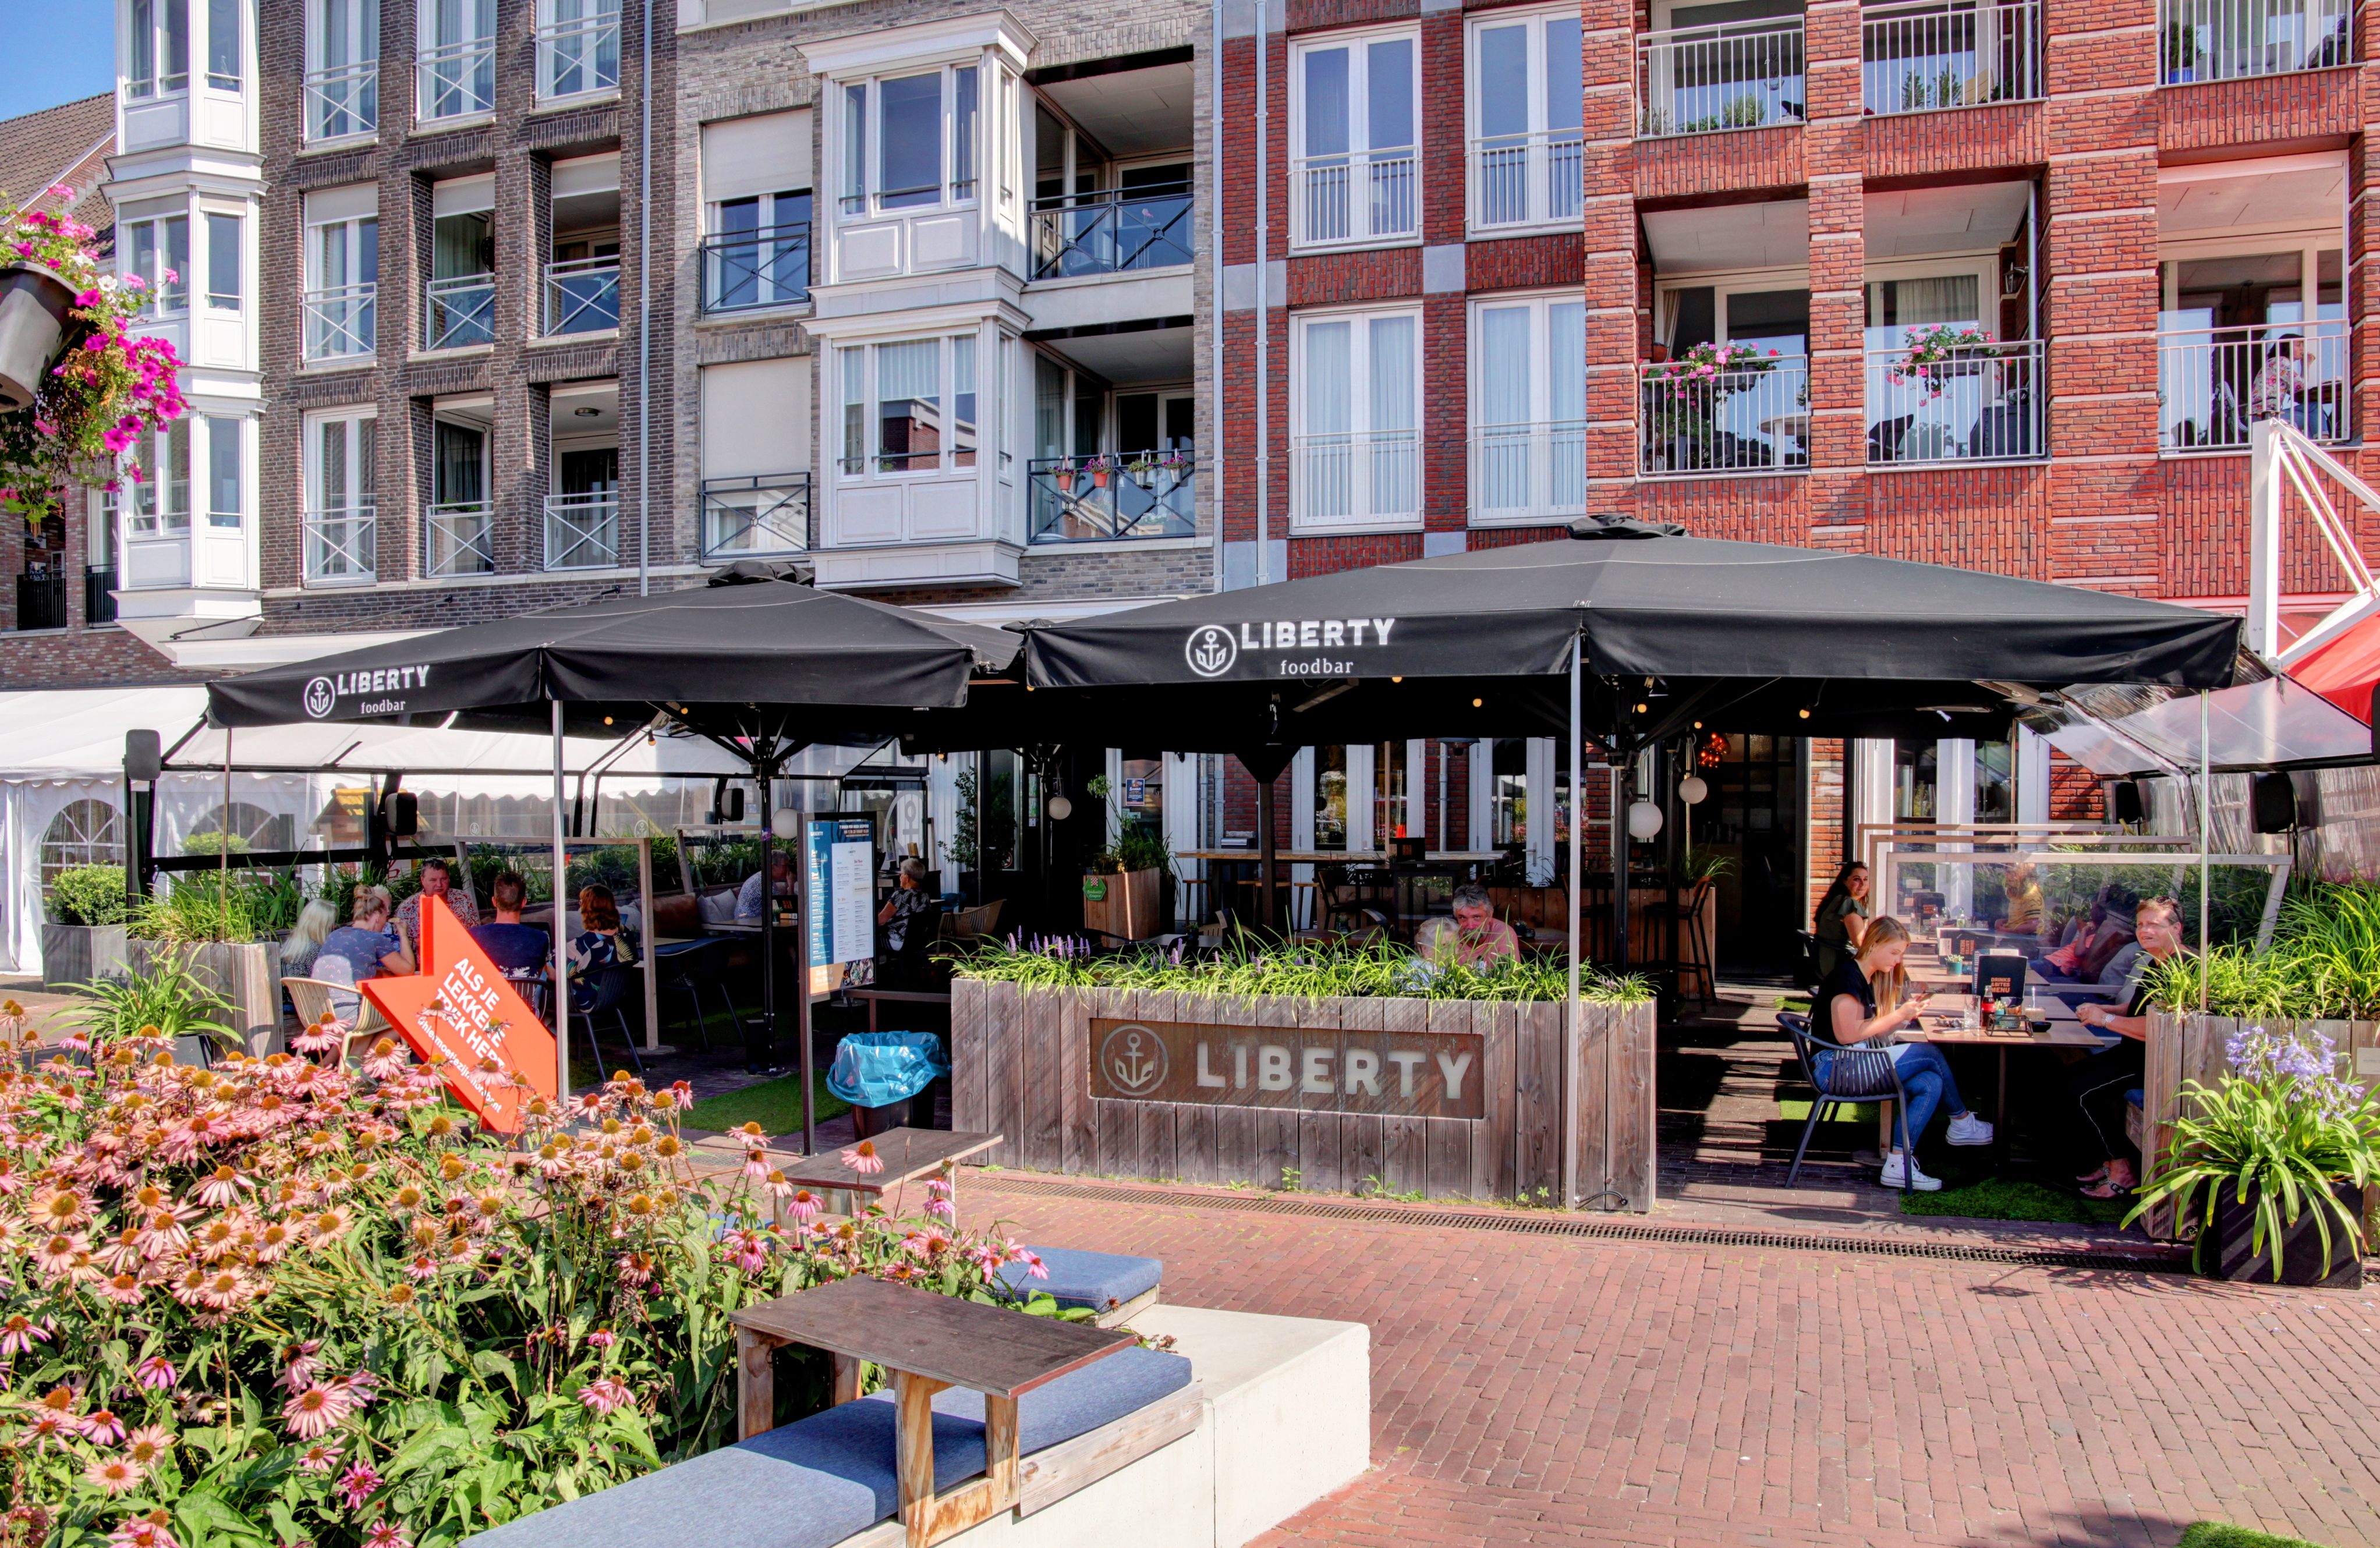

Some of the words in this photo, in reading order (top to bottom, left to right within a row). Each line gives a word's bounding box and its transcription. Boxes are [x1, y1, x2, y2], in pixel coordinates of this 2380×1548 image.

[1241, 618, 1395, 649] LIBERTY
[337, 664, 430, 695] LIBERTY
[1281, 658, 1354, 675] foodbar
[360, 699, 406, 714] foodbar
[454, 958, 484, 991] ALS
[479, 987, 500, 1012] JE
[417, 1016, 502, 1113] #hiermoetjezijnnbrabant
[1196, 1041, 1473, 1099] LIBERTY
